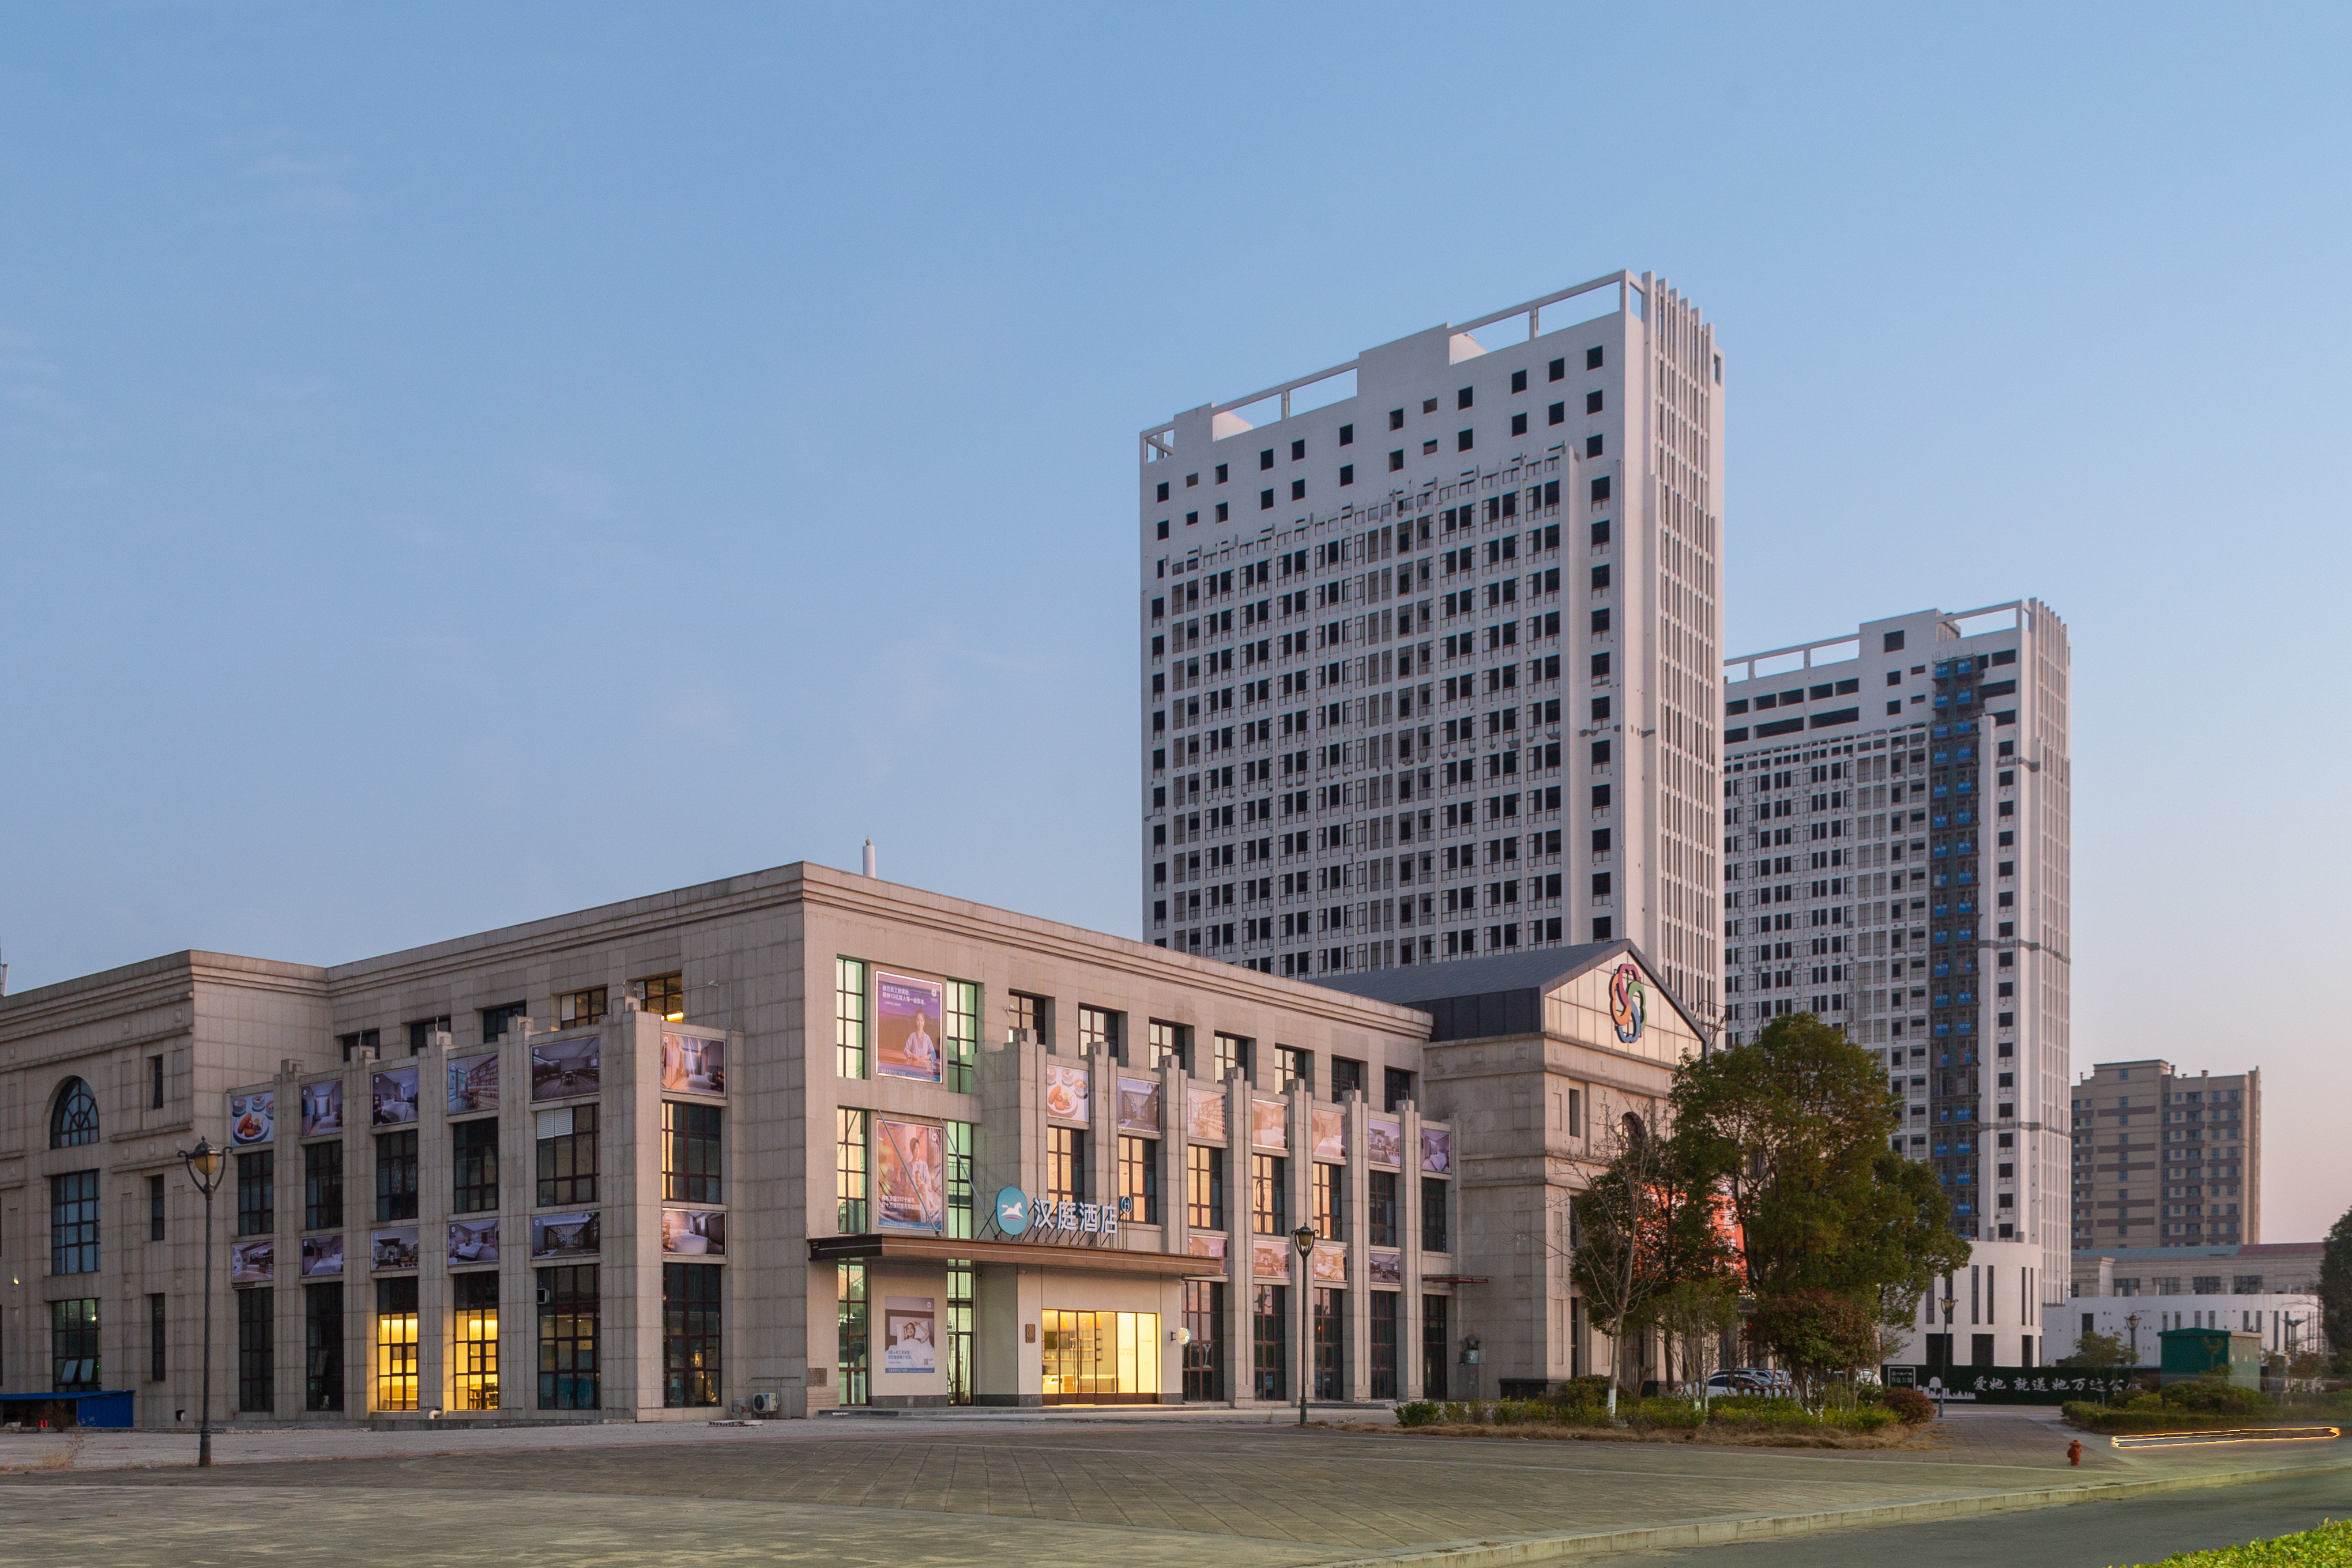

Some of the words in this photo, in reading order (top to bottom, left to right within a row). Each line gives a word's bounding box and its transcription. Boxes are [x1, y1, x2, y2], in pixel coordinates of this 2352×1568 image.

[1033, 1197, 1117, 1234] 汉庭酒店
[1974, 1375, 2006, 1392] 爱她
